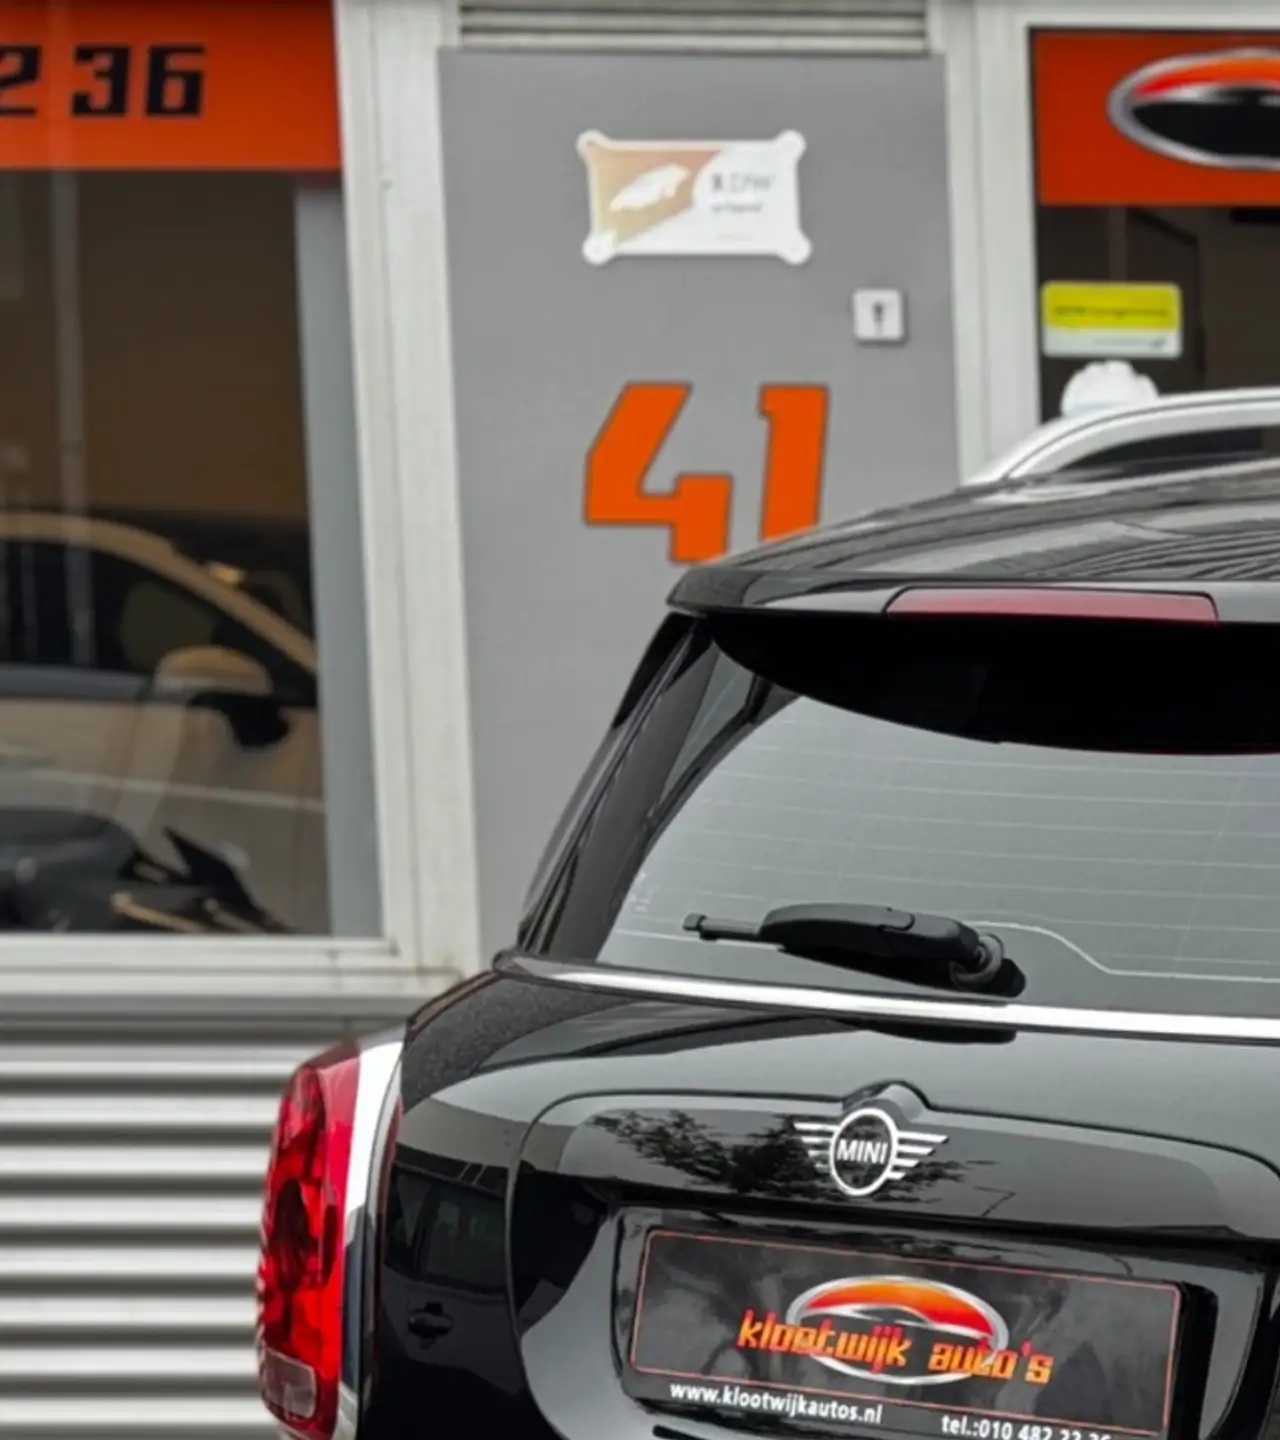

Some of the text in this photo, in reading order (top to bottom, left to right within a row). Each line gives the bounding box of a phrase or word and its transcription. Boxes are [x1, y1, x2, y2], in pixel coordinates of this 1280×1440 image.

[70, 43, 208, 118] 36
[583, 380, 832, 567] 41
[835, 1138, 889, 1166] MINI
[736, 1308, 1055, 1386] klootwijk auto's
[669, 1381, 884, 1425] www.klootwijkautos.nl
